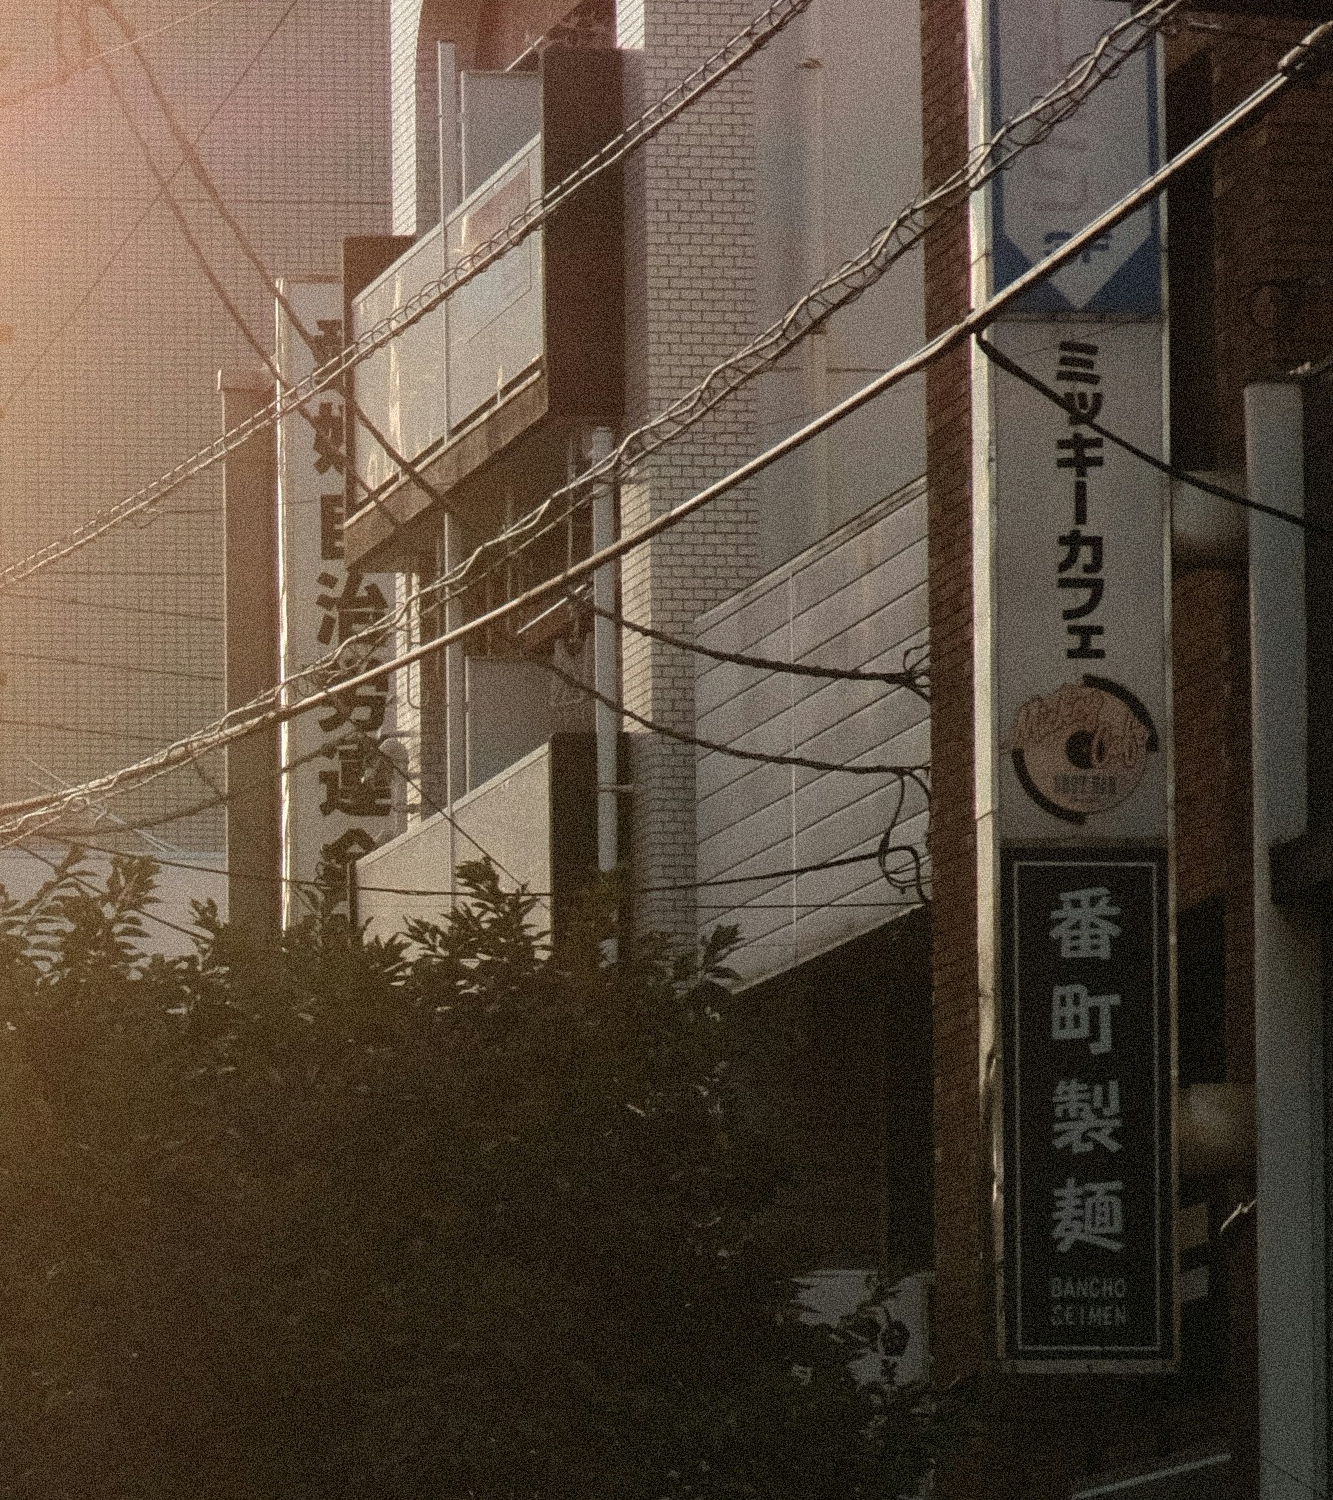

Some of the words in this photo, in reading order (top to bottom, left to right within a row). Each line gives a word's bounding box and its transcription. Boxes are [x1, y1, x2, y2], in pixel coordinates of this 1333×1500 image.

[1055, 341, 1106, 660] ミッキーカフェ
[1049, 886, 1126, 1254] 番町製麺
[1049, 1277, 1128, 1299] BANCHO
[1049, 1304, 1128, 1327] SEIMEN
